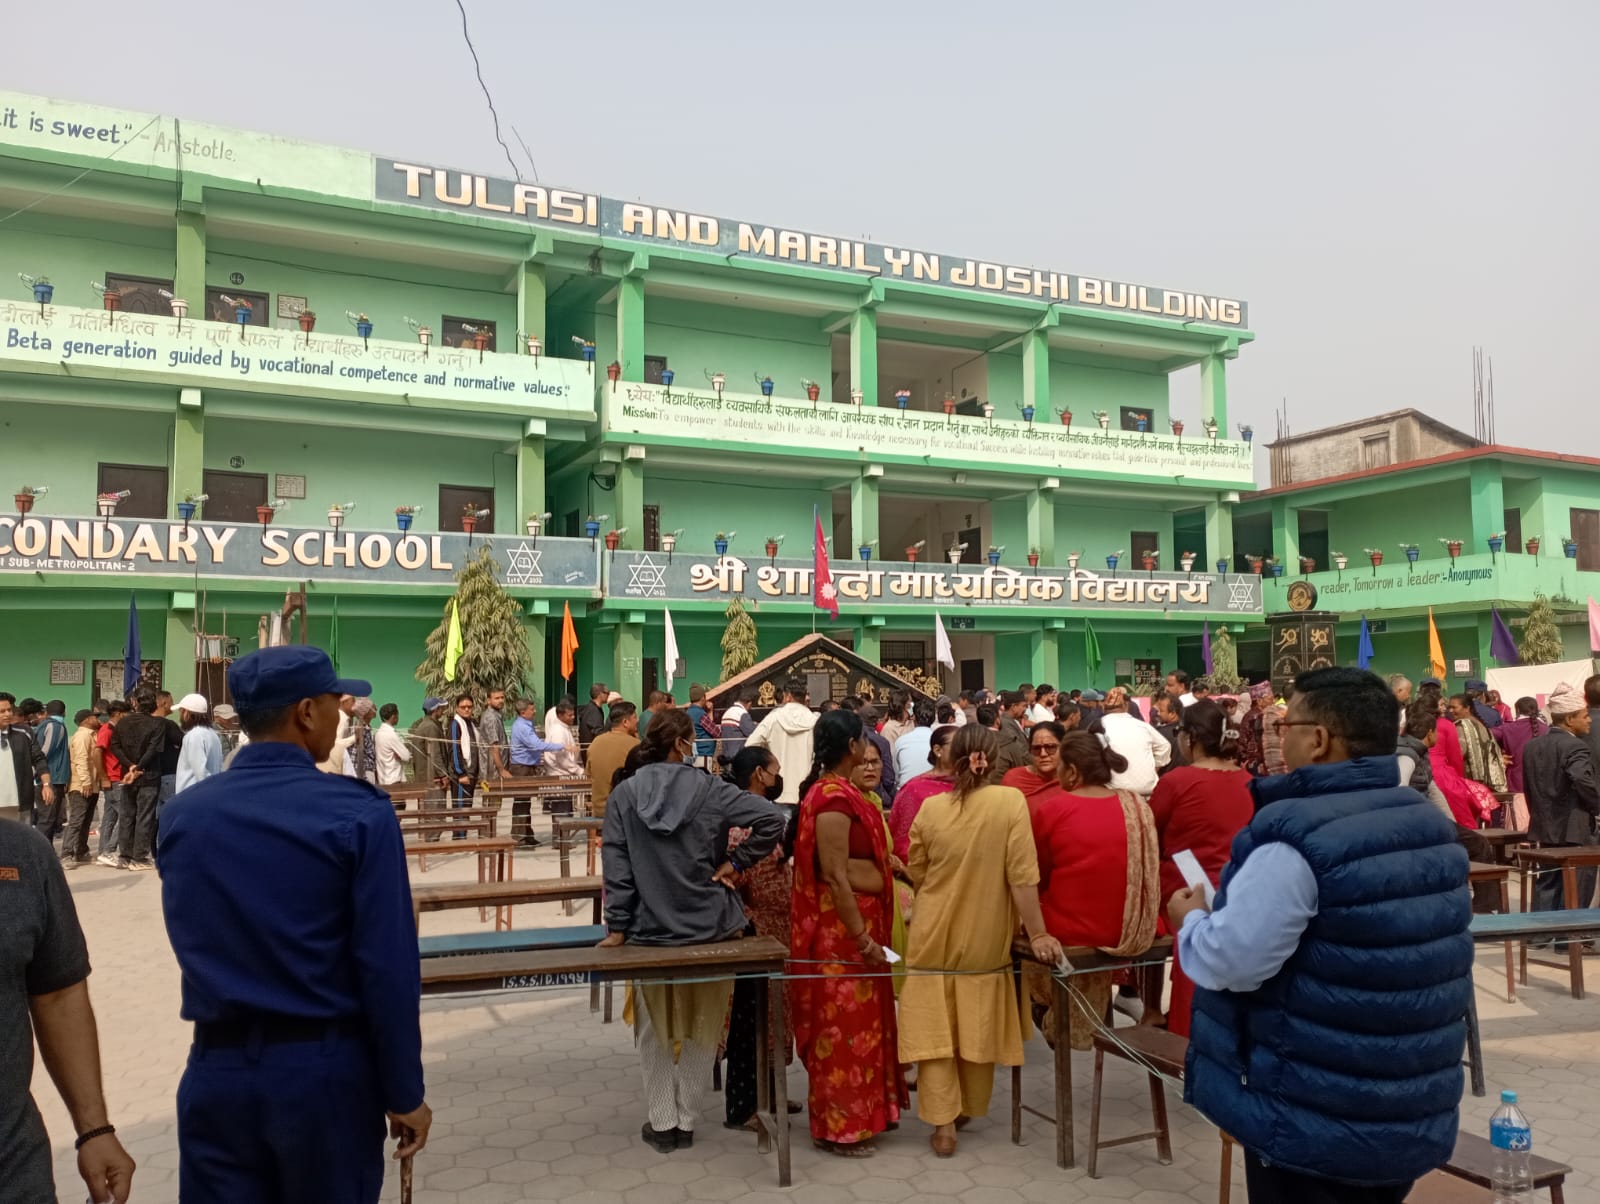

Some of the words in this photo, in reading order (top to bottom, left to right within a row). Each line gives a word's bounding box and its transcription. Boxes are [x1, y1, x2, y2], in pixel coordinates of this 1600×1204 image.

[29, 110, 44, 132] is
[154, 131, 236, 162] Arstotle.
[392, 161, 599, 228] TULASI
[621, 202, 720, 247] AND
[950, 259, 1070, 302] JOSHI
[1078, 276, 1243, 325] BUILDING
[7, 327, 52, 350] Beta
[62, 337, 158, 360] generation
[168, 346, 223, 368] guided
[230, 350, 251, 374] by
[259, 355, 334, 376] vocational
[339, 364, 418, 384] competence
[424, 371, 446, 386] and
[454, 375, 516, 392] normative
[674, 414, 717, 426] empower
[261, 528, 453, 571] SCHOOL
[689, 556, 748, 593] श्री
[757, 565, 886, 600] शादा
[1067, 568, 1212, 605] विद्यालय
[1353, 577, 1394, 593] Tomorrow
[1396, 578, 1403, 587] a
